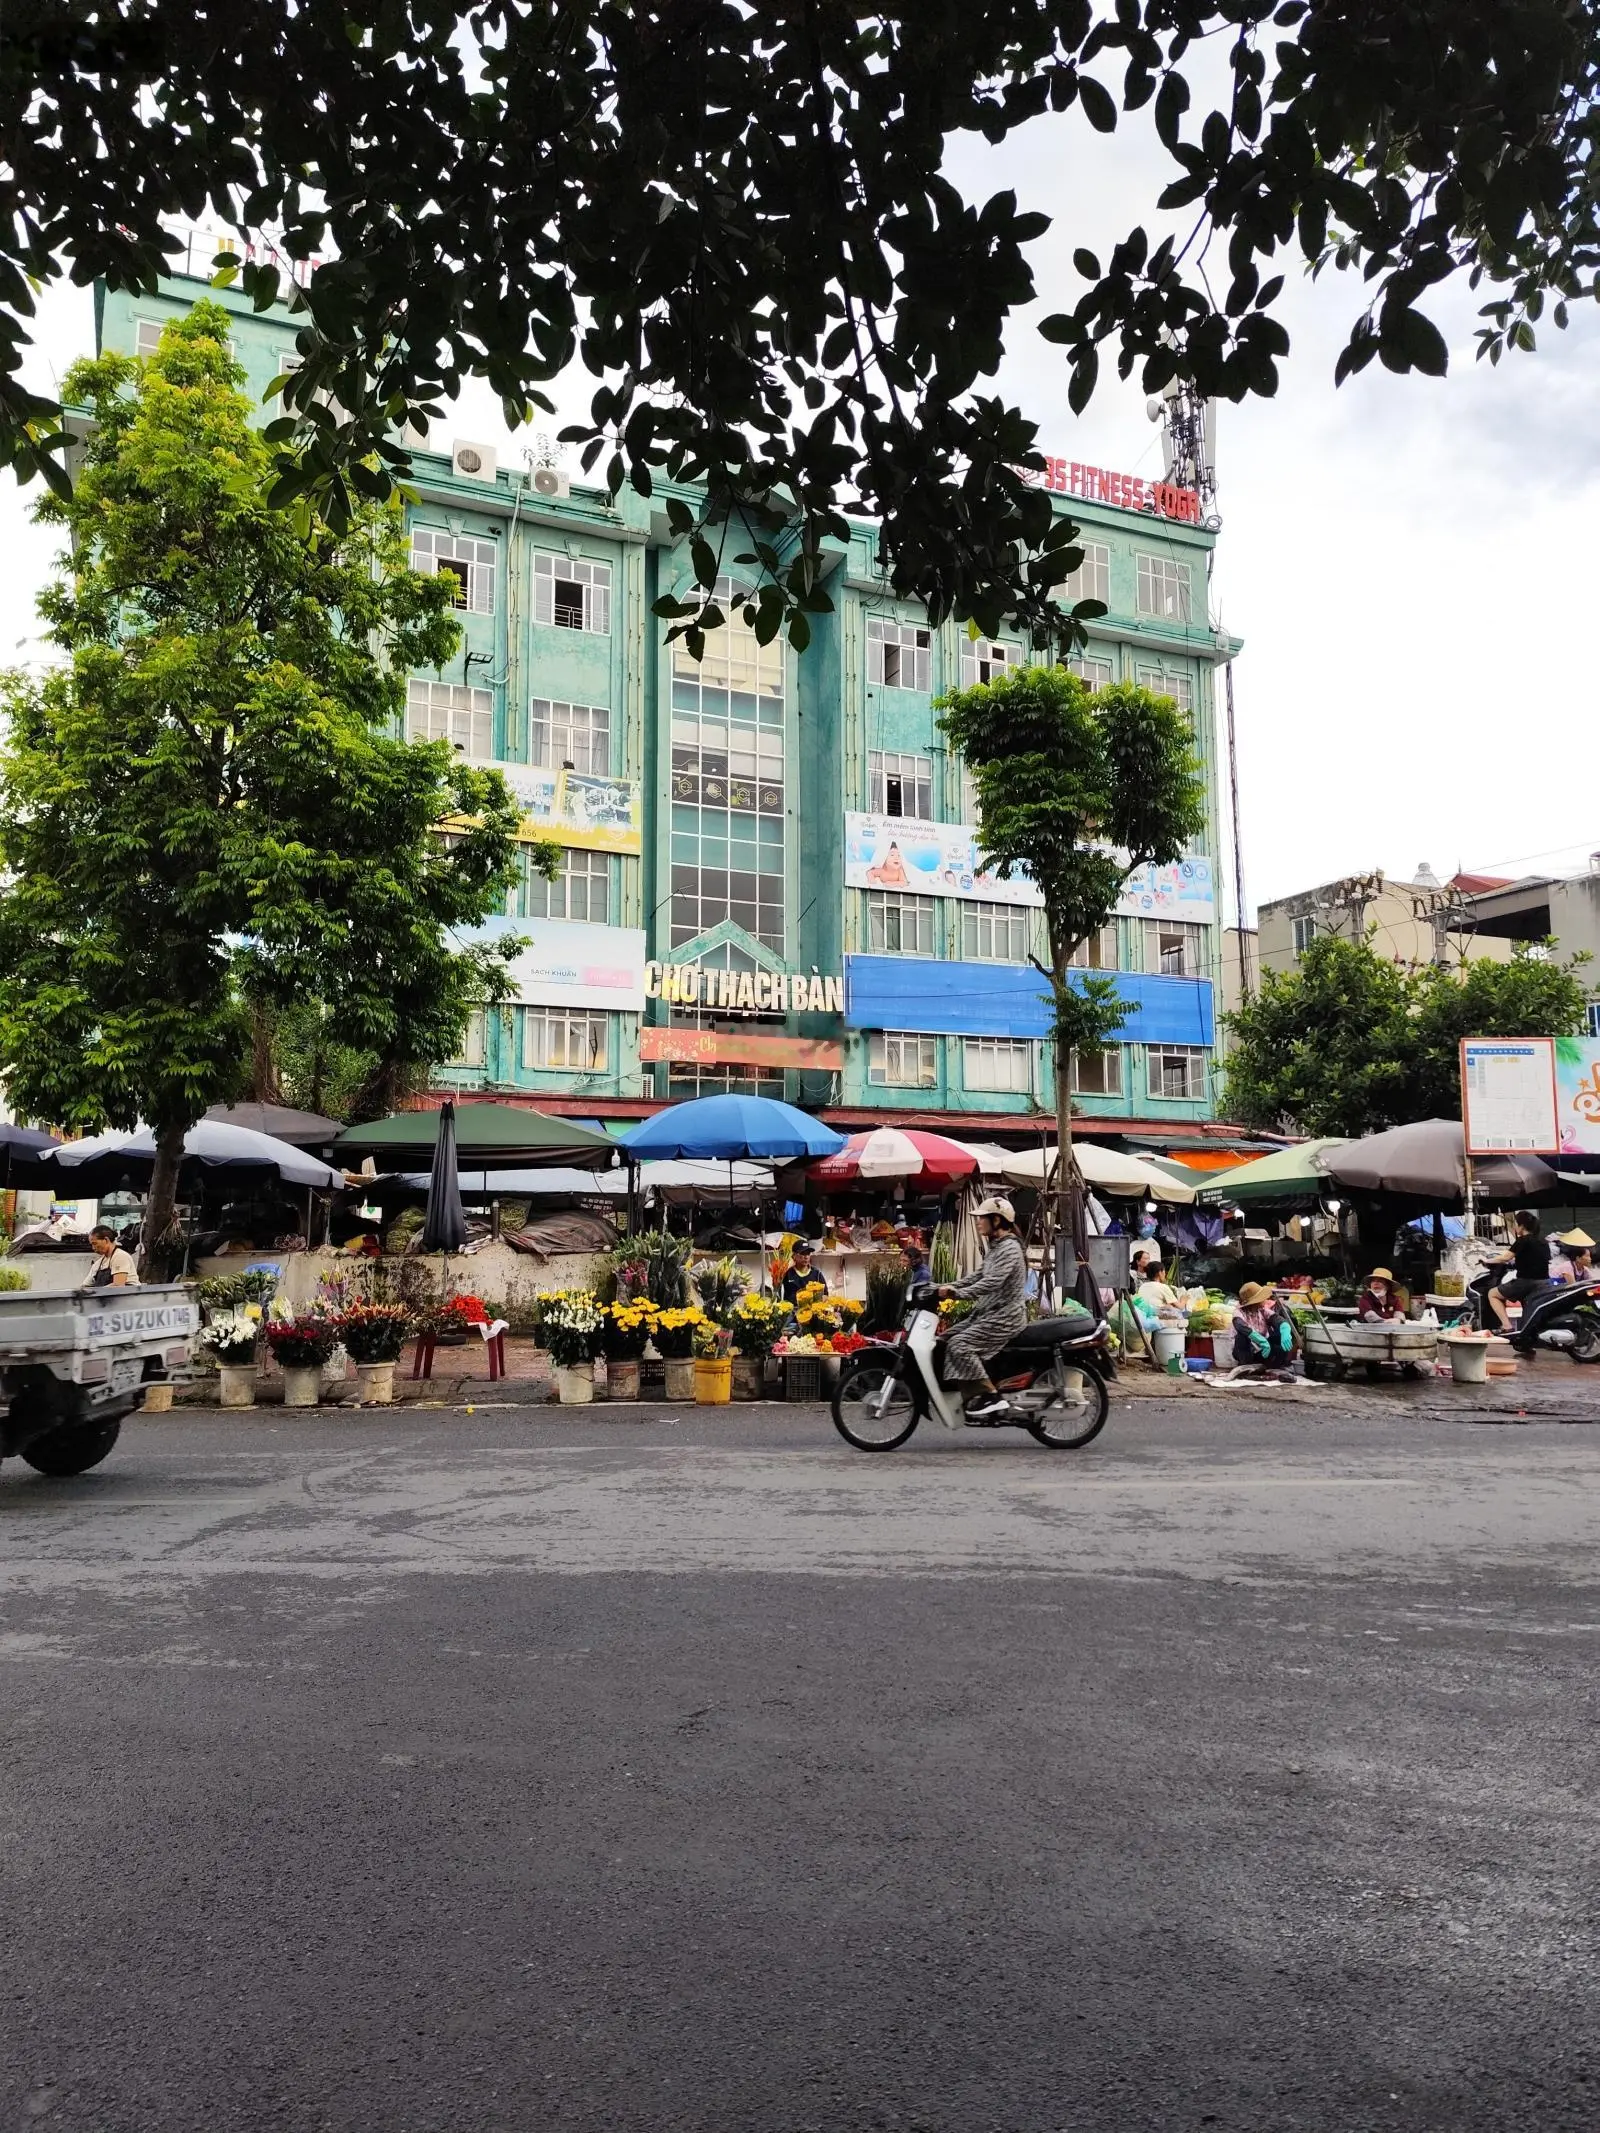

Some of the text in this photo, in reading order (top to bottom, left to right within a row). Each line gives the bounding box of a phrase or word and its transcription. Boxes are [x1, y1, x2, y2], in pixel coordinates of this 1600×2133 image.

[1070, 461, 1144, 510] FITNESS
[1152, 480, 1199, 524] YOGA
[791, 965, 844, 1012] BÀN
[111, 1309, 171, 1332] SUZUKI
